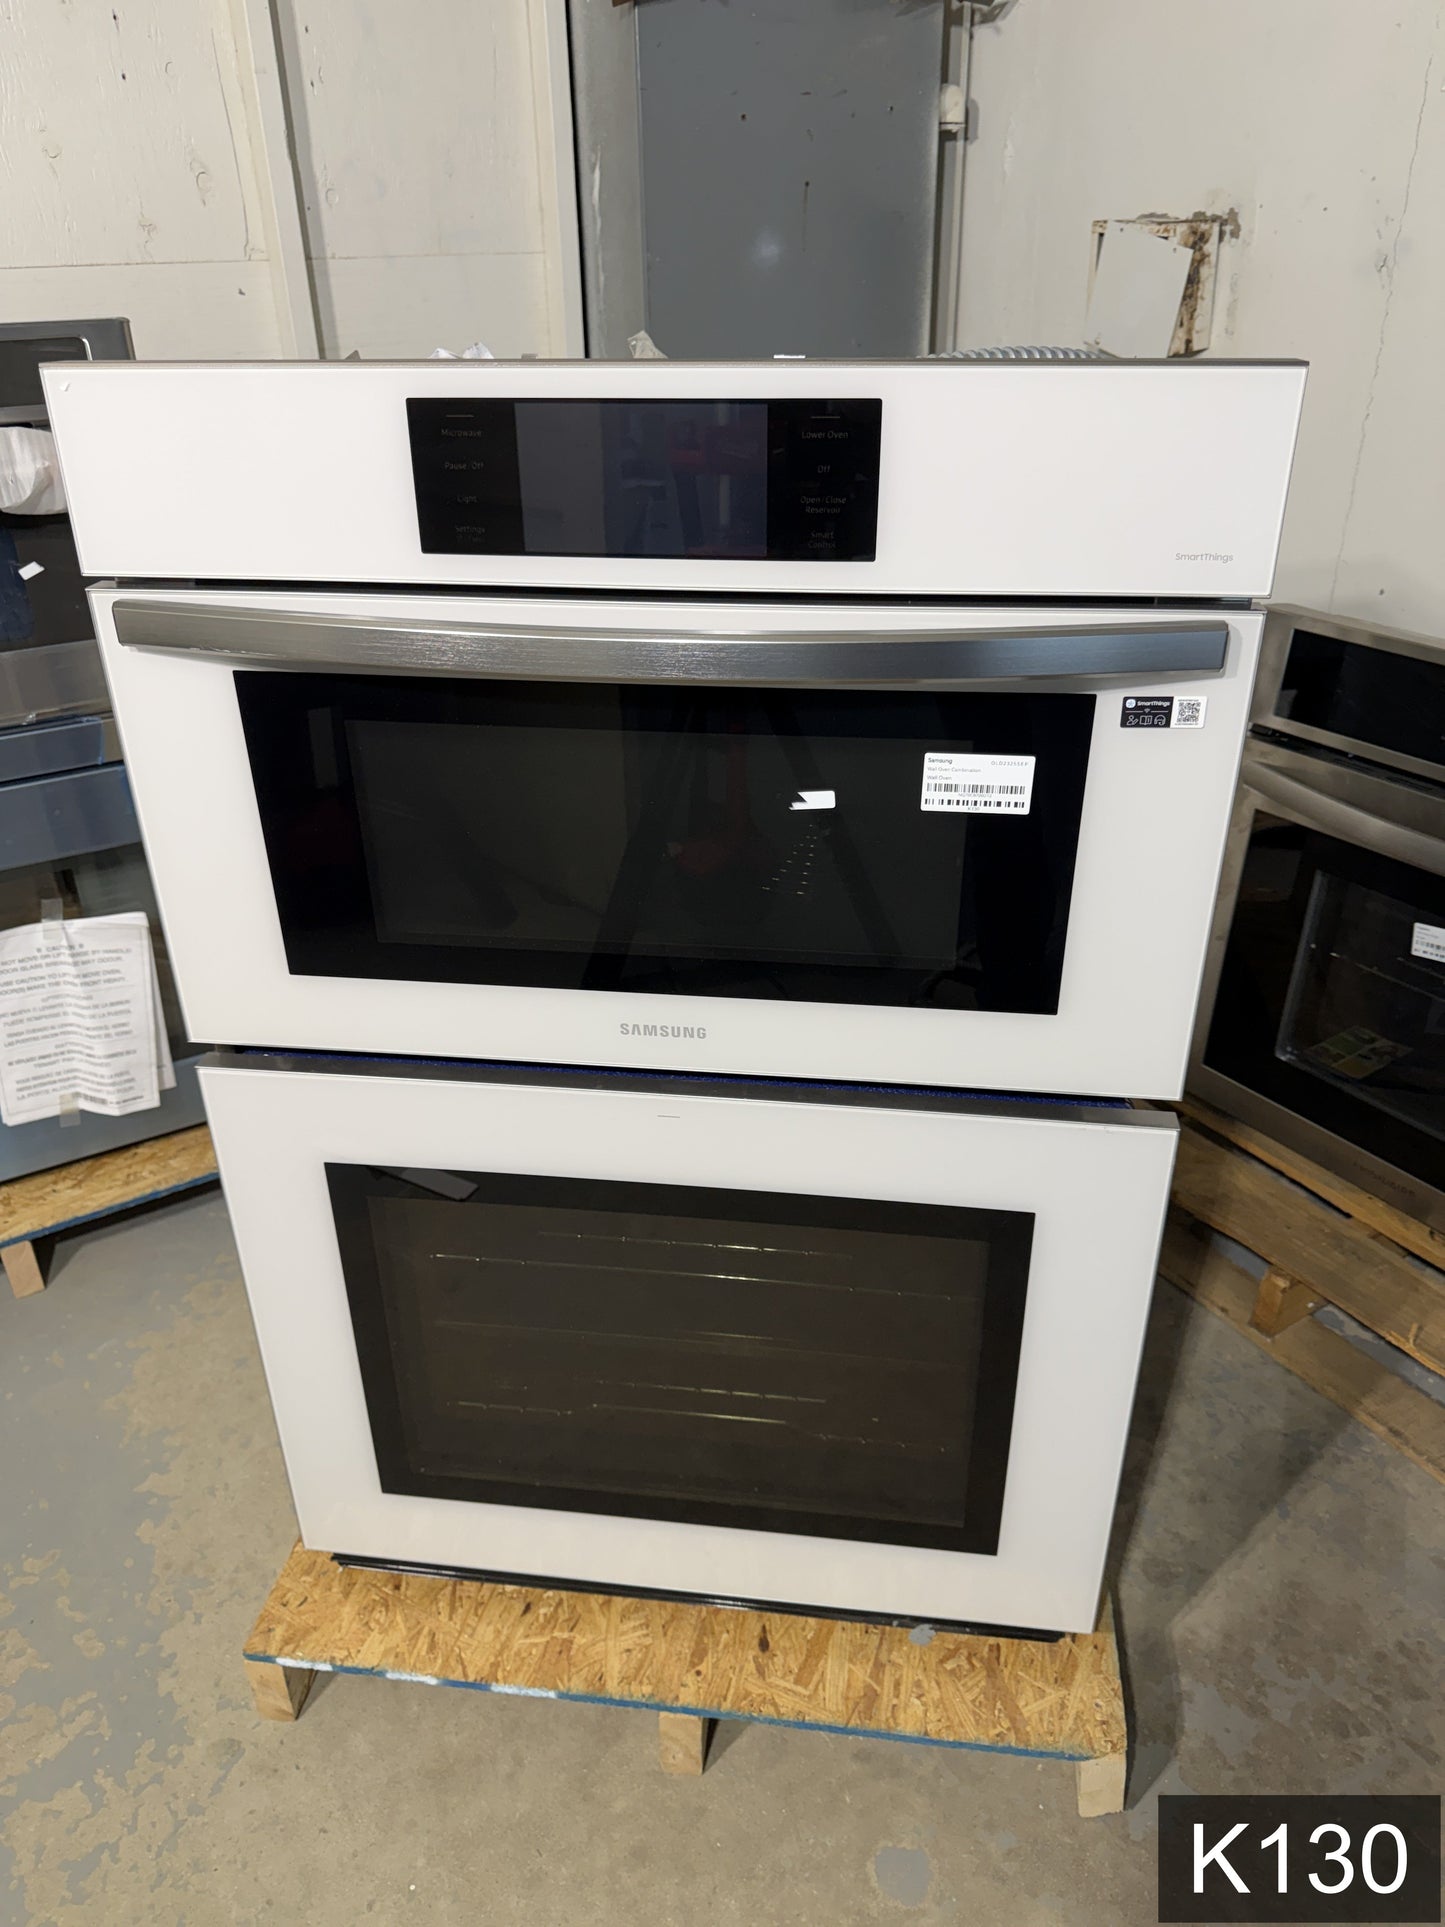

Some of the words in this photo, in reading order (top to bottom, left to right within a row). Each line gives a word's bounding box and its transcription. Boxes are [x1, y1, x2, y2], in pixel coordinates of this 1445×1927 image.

[802, 431, 826, 440] Lower
[827, 430, 849, 439] Oven
[817, 464, 831, 474] Off
[1175, 552, 1234, 564] SmartThings
[928, 757, 953, 765] Samsung
[620, 1022, 707, 1040] SAMSUNG
